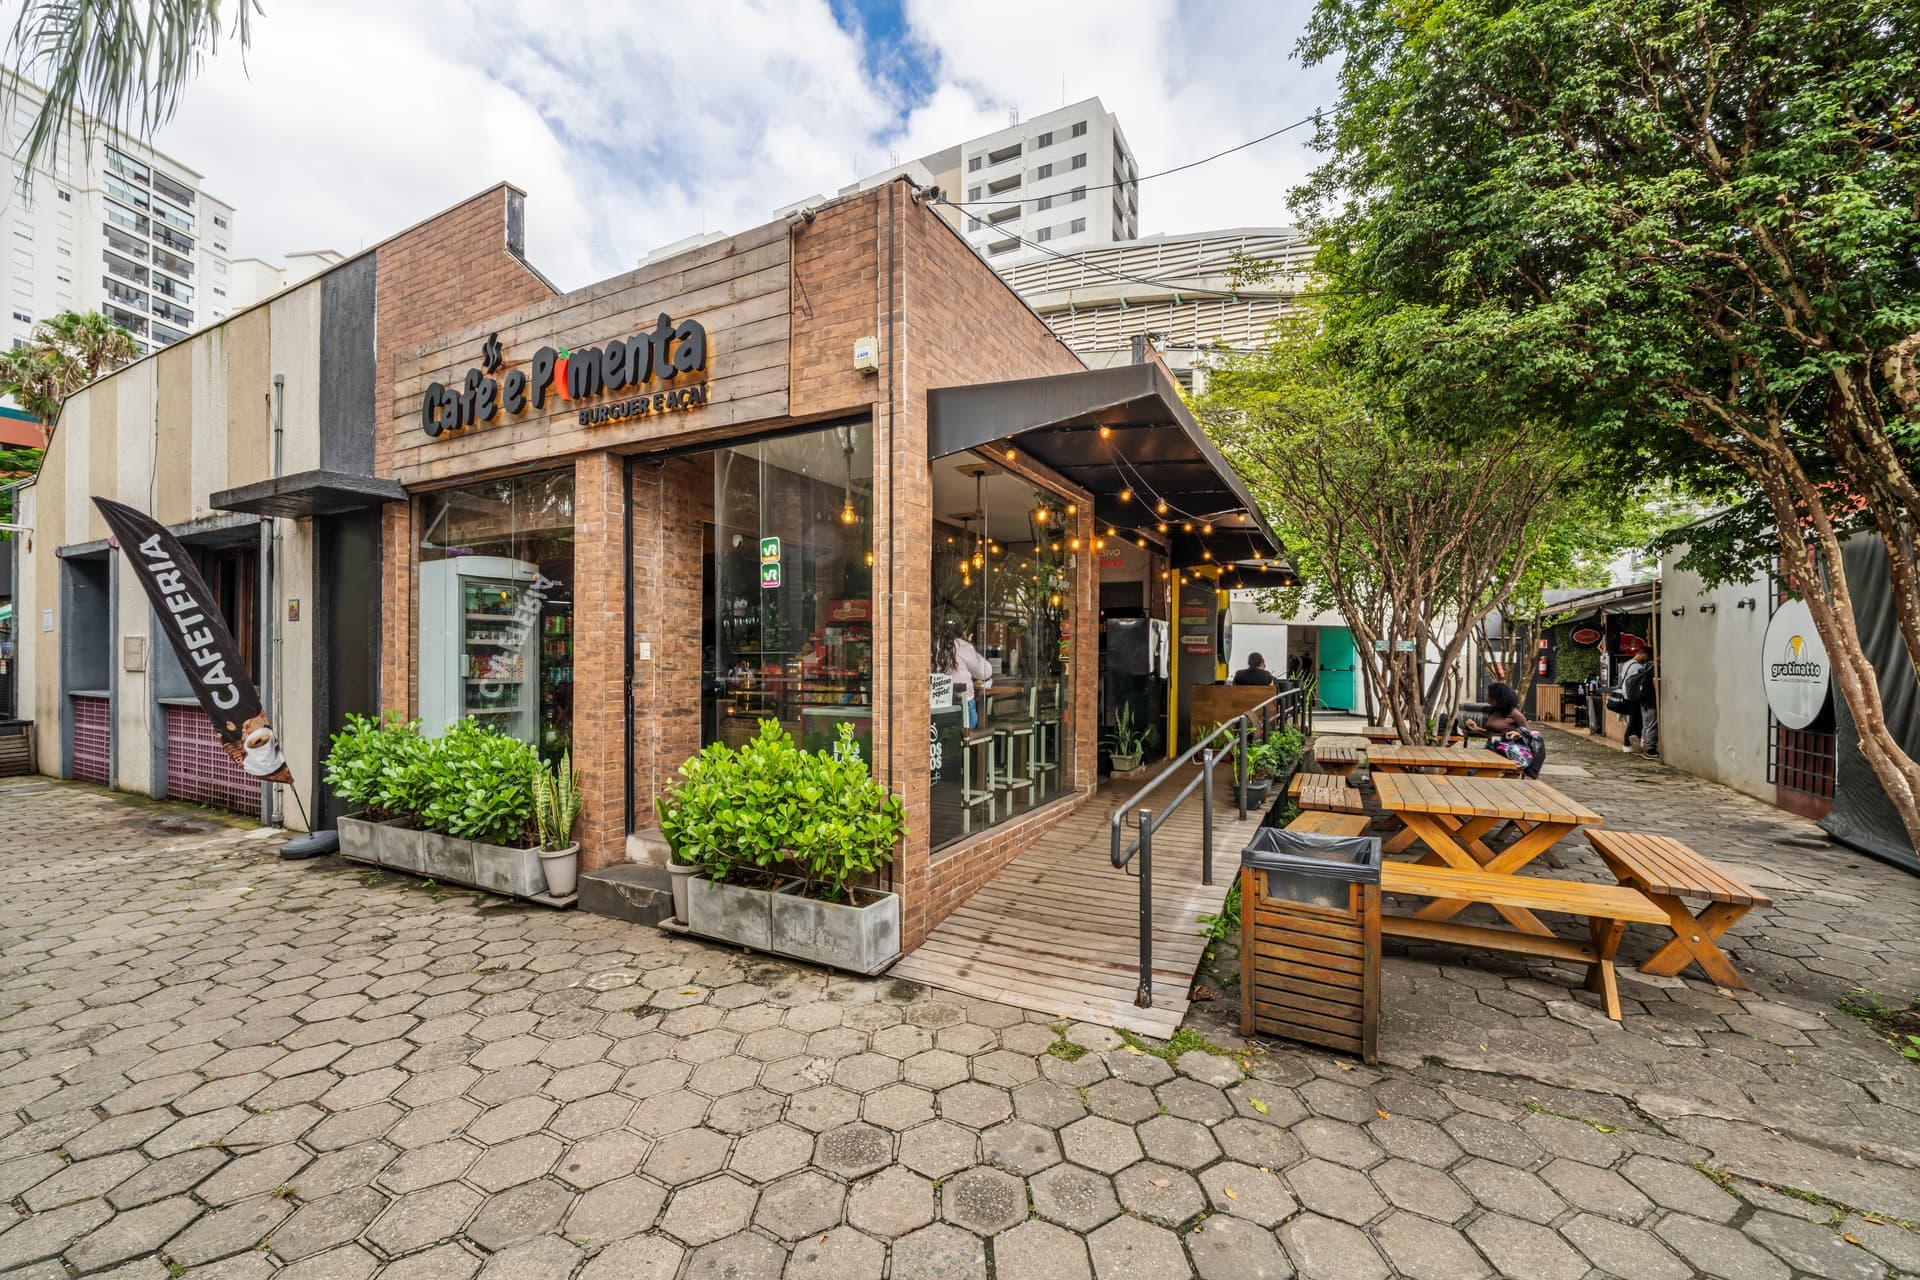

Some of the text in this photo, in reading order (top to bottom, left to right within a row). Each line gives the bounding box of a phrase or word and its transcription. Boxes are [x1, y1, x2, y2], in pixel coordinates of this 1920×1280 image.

[504, 370, 527, 414] e
[531, 312, 708, 409] Pimenta
[579, 380, 708, 427] BURGUER E AÇAÍ
[139, 533, 240, 709] CAFETERIA
[1771, 661, 1821, 678] gratinatto
